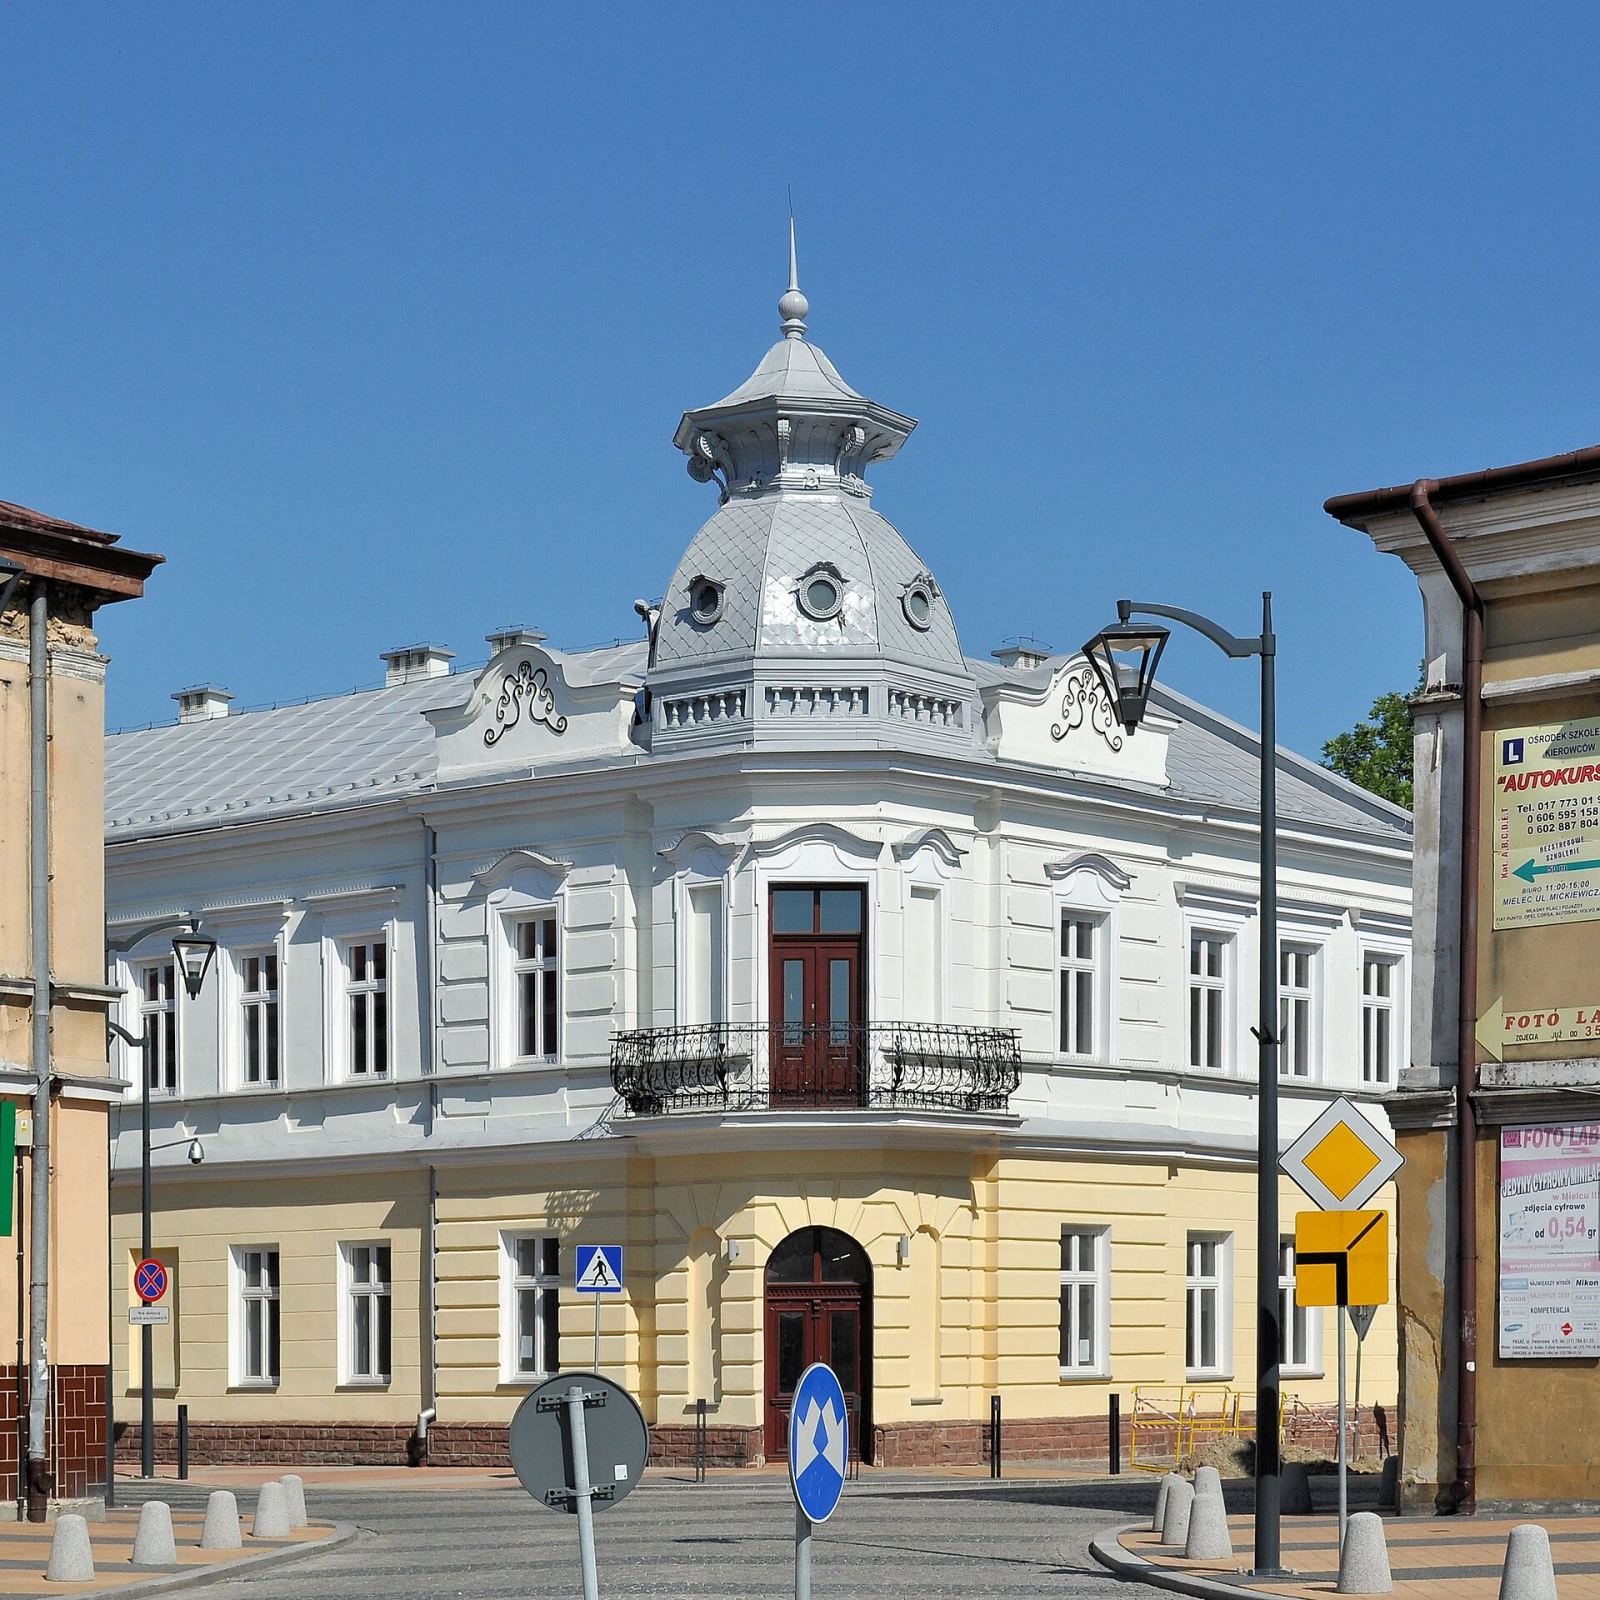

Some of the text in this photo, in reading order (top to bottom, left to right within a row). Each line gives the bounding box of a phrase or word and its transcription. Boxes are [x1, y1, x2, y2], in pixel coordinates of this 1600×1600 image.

[1528, 727, 1600, 745] OŚRODEK SZKOLE
[1545, 743, 1596, 757] KIEROWCÓW
[1517, 803, 1535, 813] Tel.
[1537, 800, 1556, 811] 017
[1559, 798, 1578, 808] 773
[1581, 796, 1593, 805] 01
[1527, 807, 1599, 823] 0 606 595 158
[1527, 818, 1599, 835] 0 602 887 804
[1546, 847, 1580, 861] SZKOLENIE
[1545, 880, 1590, 892] 11:00-16:00
[1502, 895, 1532, 905] MIELEC
[1549, 888, 1600, 901] MICKIEWICZ
[1504, 1009, 1600, 1030] FOTO LA
[1522, 1127, 1565, 1149] FOTO
[1569, 1124, 1600, 1147] LAB
[1561, 1190, 1589, 1200] Mielcu
[1524, 1202, 1586, 1213] zdjęcia cyfrowe
[1534, 1216, 1597, 1242] od 0,54 gr
[1575, 1279, 1599, 1287] Nikon
[1530, 1306, 1570, 1314] KOMPETENCJA
